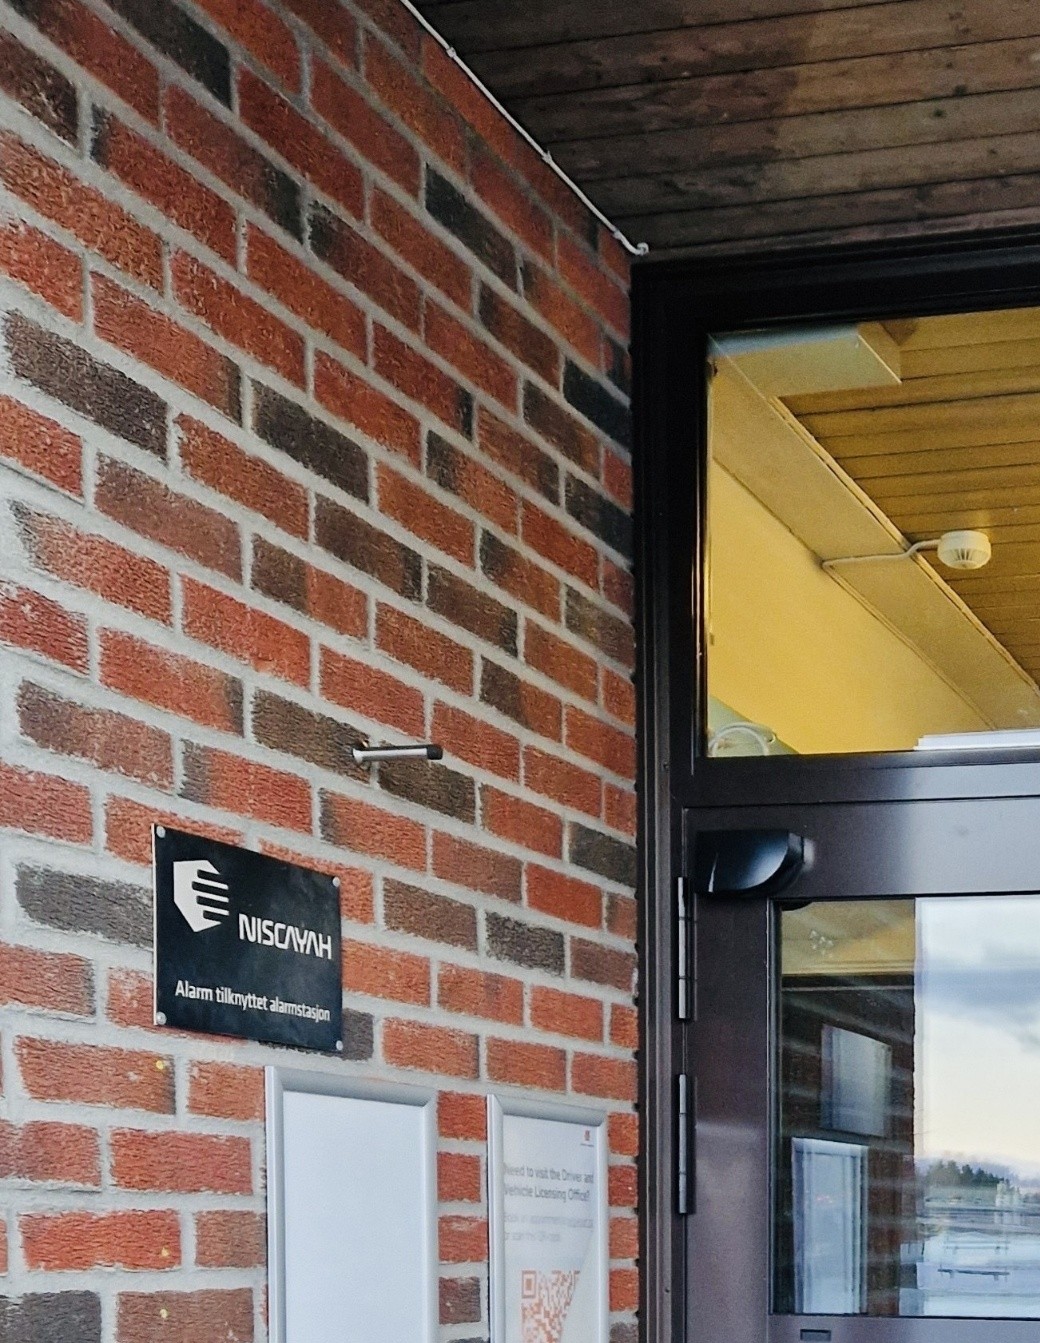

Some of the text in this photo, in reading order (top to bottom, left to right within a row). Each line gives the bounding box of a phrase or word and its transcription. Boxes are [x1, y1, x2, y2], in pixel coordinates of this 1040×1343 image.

[238, 913, 332, 960] NISCAYAH
[175, 980, 330, 1022] Alarm tilknyttet alarmstasjon
